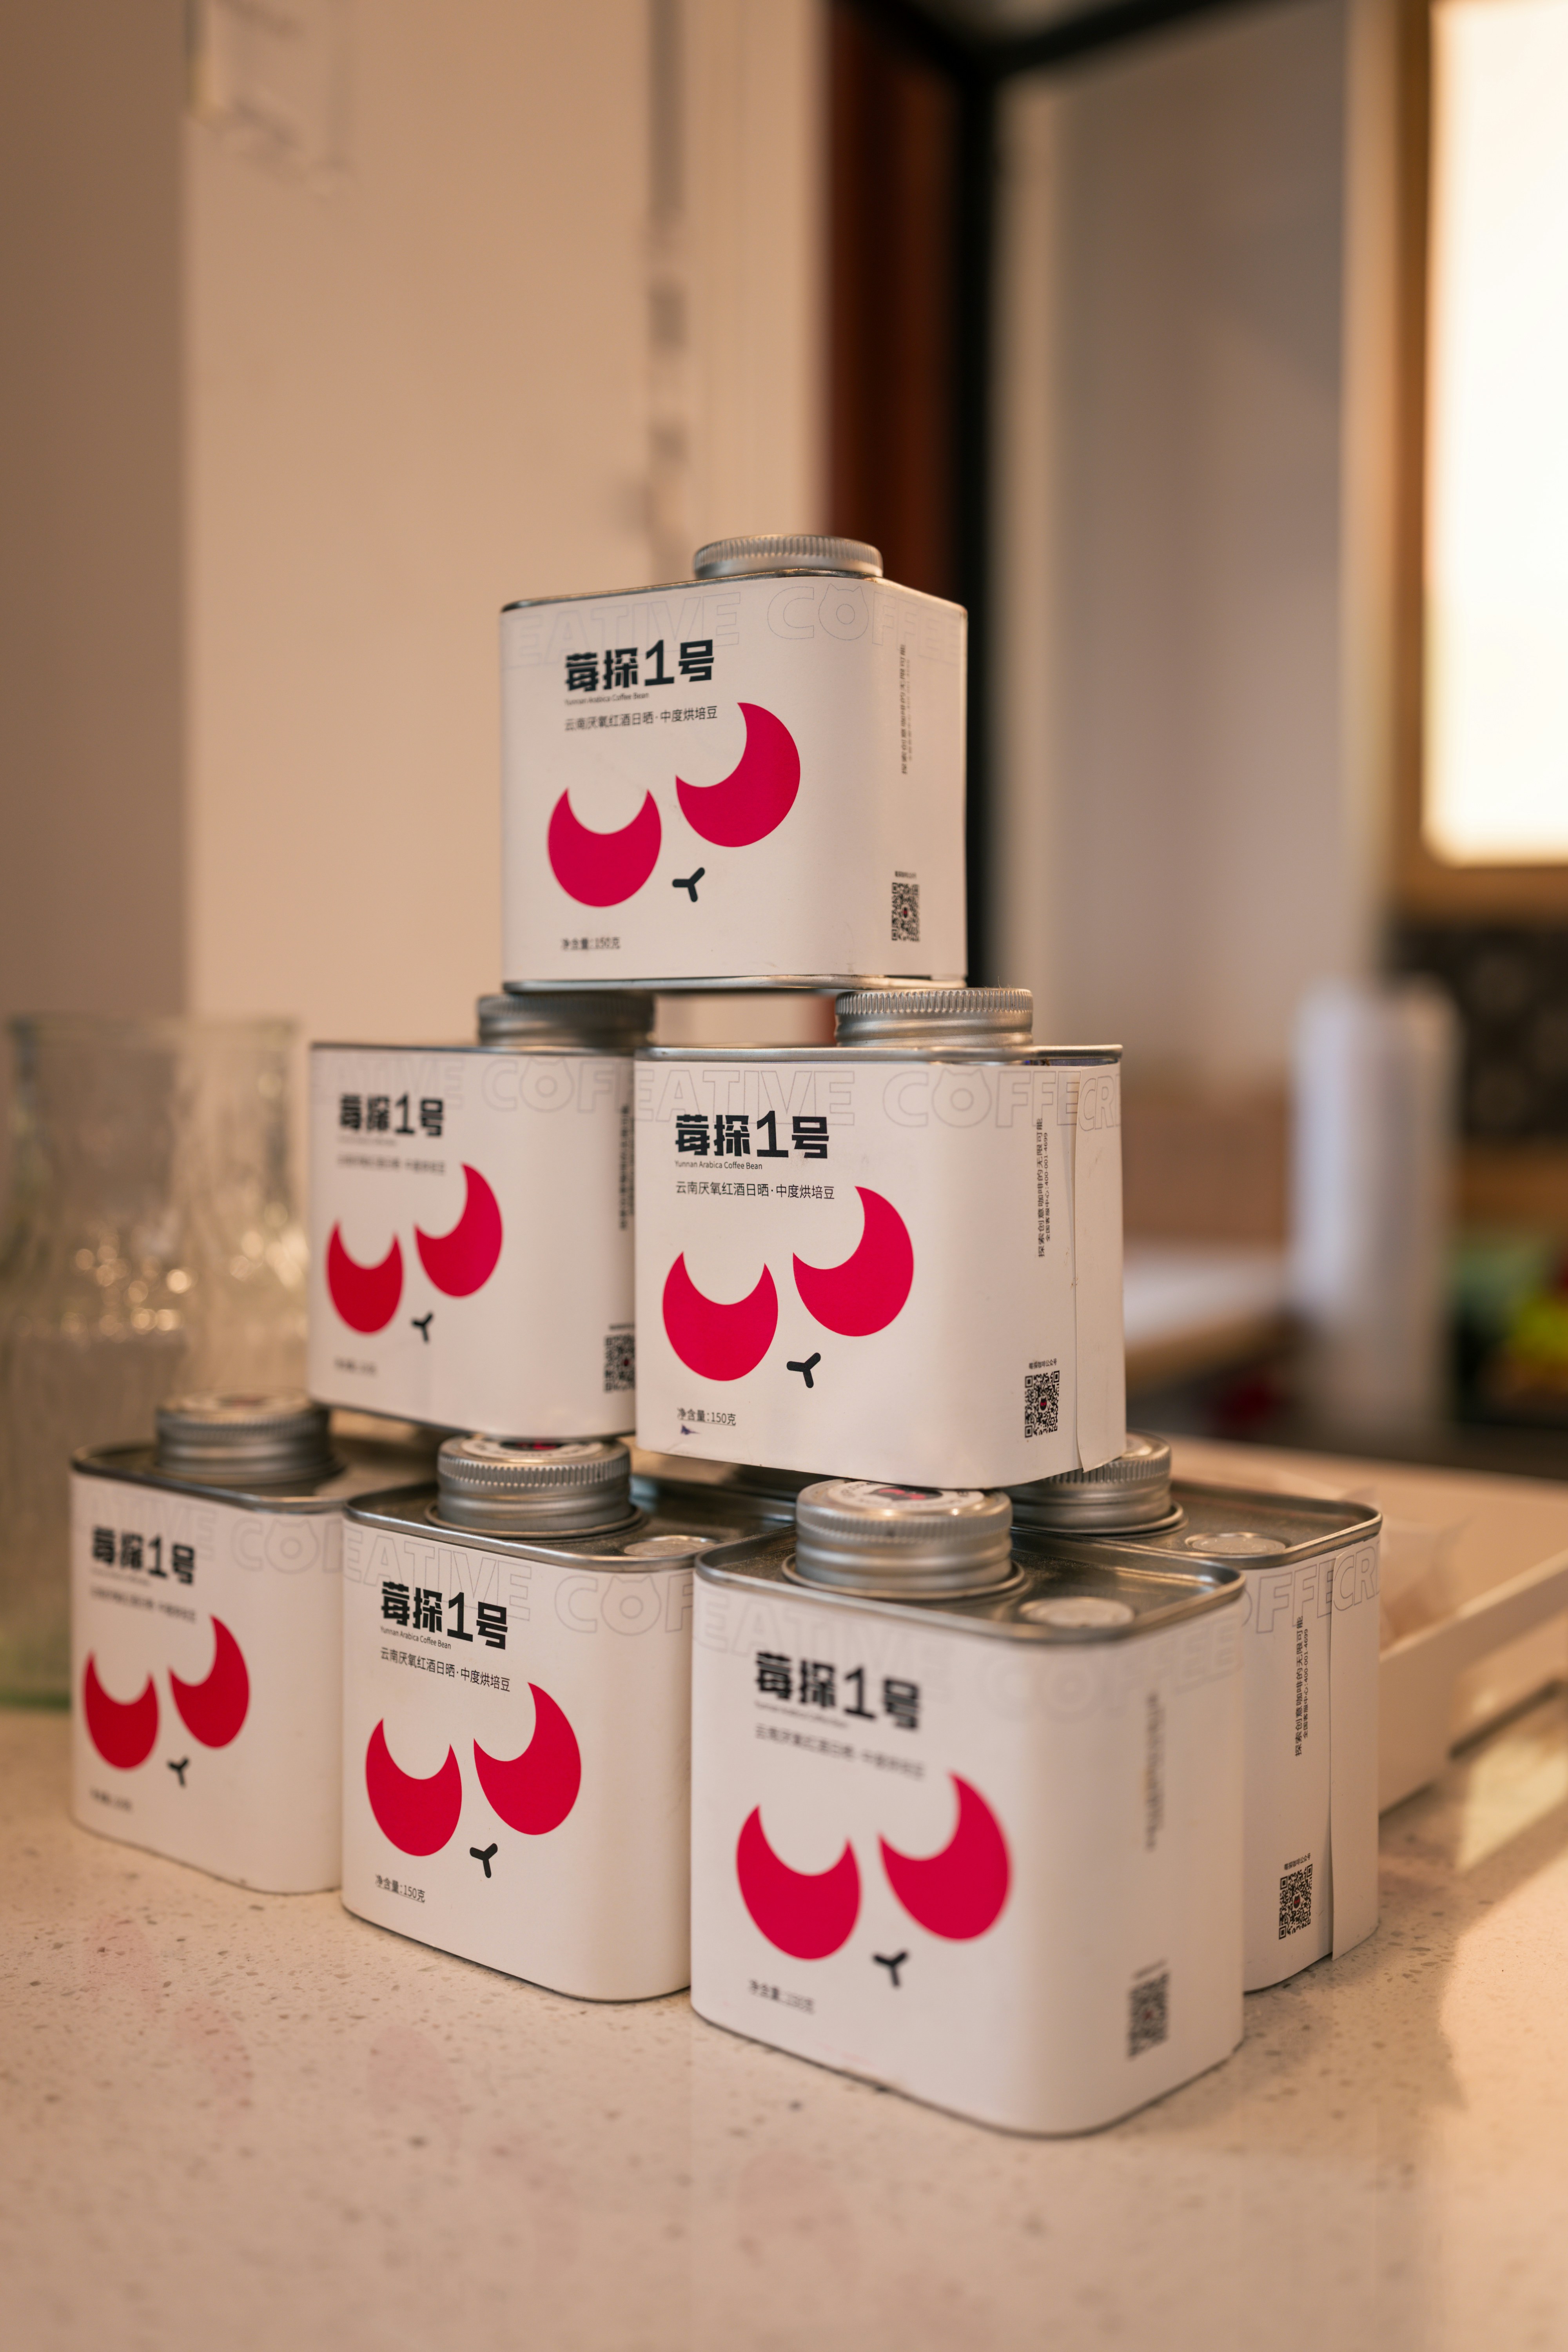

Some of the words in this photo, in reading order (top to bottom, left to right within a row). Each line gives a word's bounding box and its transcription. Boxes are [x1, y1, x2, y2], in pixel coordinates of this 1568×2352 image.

[565, 639, 714, 691] 莓探1号
[612, 693, 632, 701] Coffee
[675, 1110, 829, 1159] 莓探1号
[724, 1161, 745, 1169] Coffee
[1036, 1118, 1045, 1258] 探索创意咖啡的无限可能
[675, 1181, 835, 1200] 云南厌氧红酒日晒·中度烘培豆
[380, 1625, 399, 1636] Yunnan
[399, 1631, 419, 1642] Arabica
[420, 1635, 437, 1646] Coffee
[437, 1639, 451, 1650] Bean
[381, 1581, 508, 1650] 莓探1号
[380, 1646, 510, 1693] 云南厌氧红酒日晒·中度烘培豆
[1294, 1615, 1303, 1758] 探索创意咖啡的无限可能
